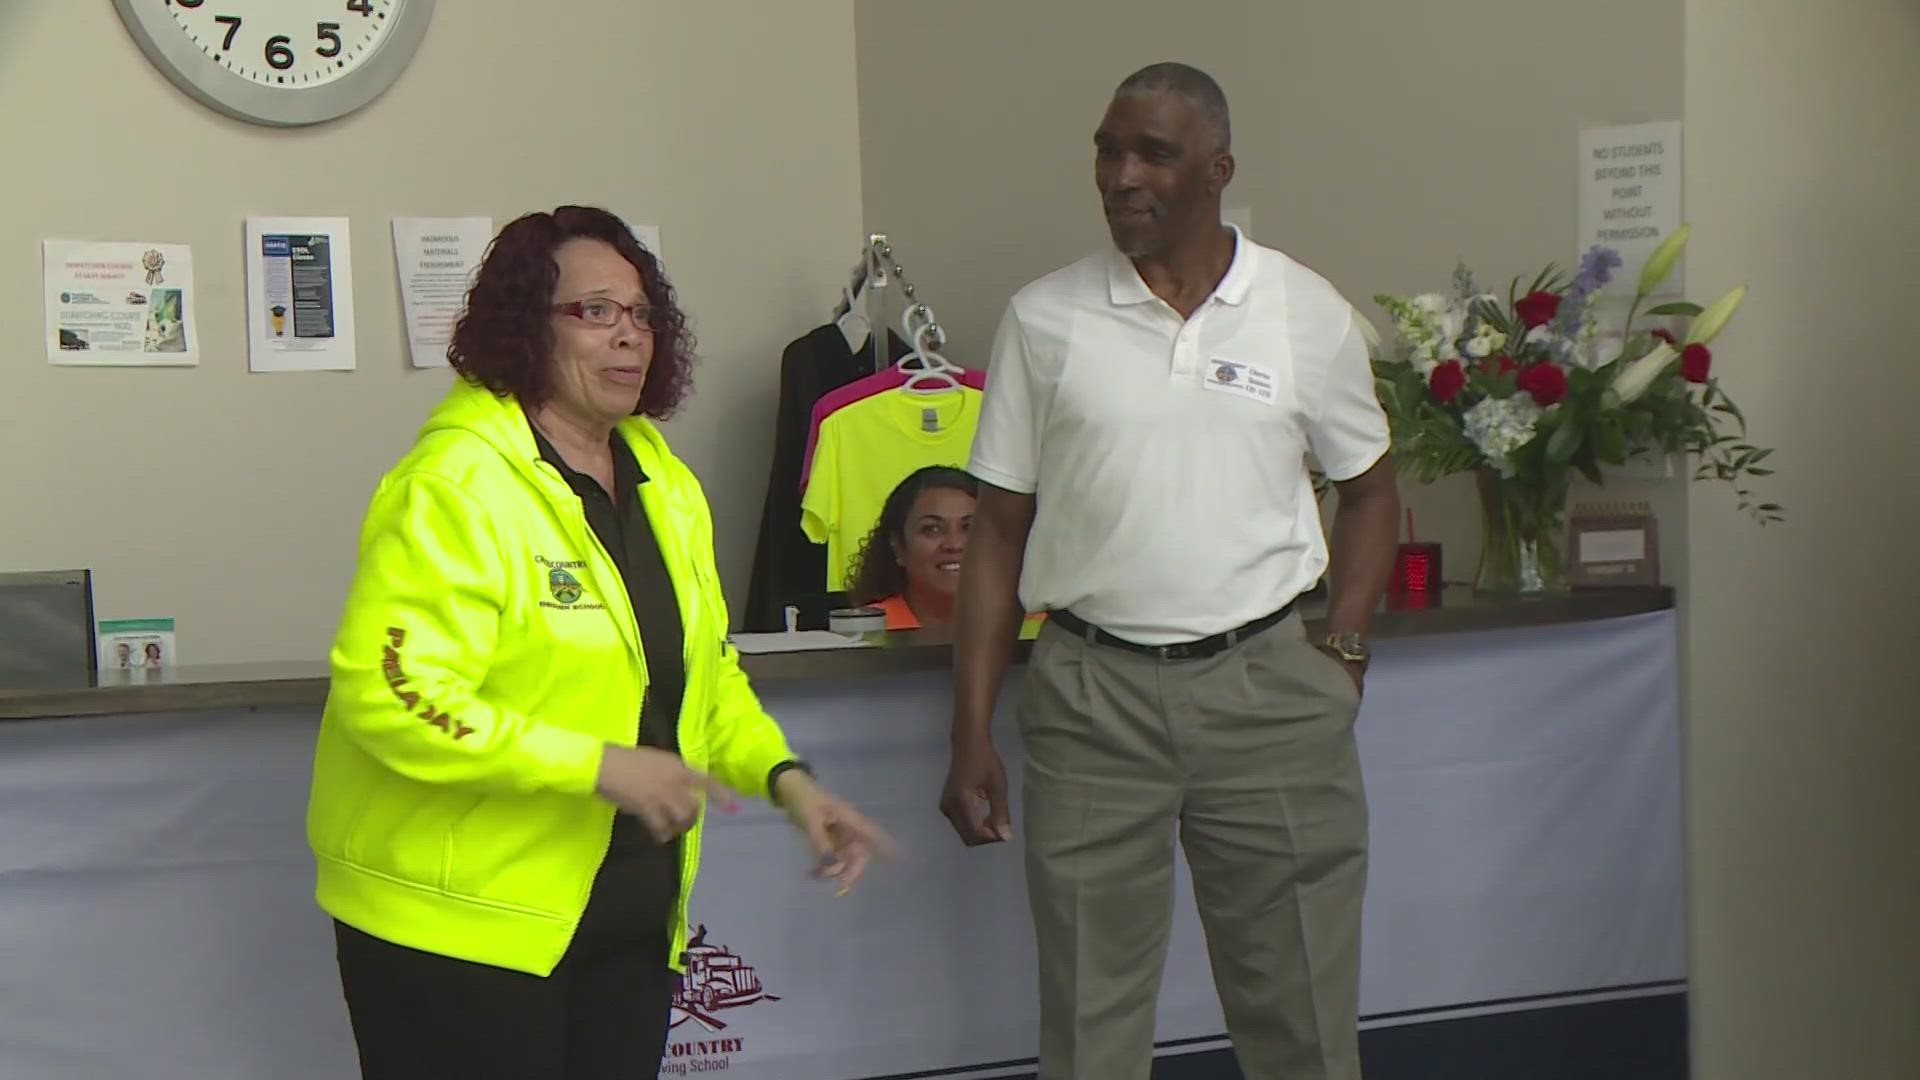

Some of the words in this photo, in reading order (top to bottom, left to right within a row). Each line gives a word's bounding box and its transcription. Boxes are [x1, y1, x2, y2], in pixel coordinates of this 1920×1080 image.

[215, 15, 242, 51] 7
[315, 22, 342, 57] 5
[264, 35, 294, 70] 6
[1593, 147, 1608, 160] NO
[1611, 141, 1665, 159] STUDENTS
[1594, 166, 1636, 181] BEYOND
[1638, 163, 1662, 177] THIS
[1611, 185, 1643, 199] POINT
[1603, 205, 1653, 220] WITHOUT
[1597, 226, 1660, 241] PERMISSION
[690, 1056, 729, 1073] School
